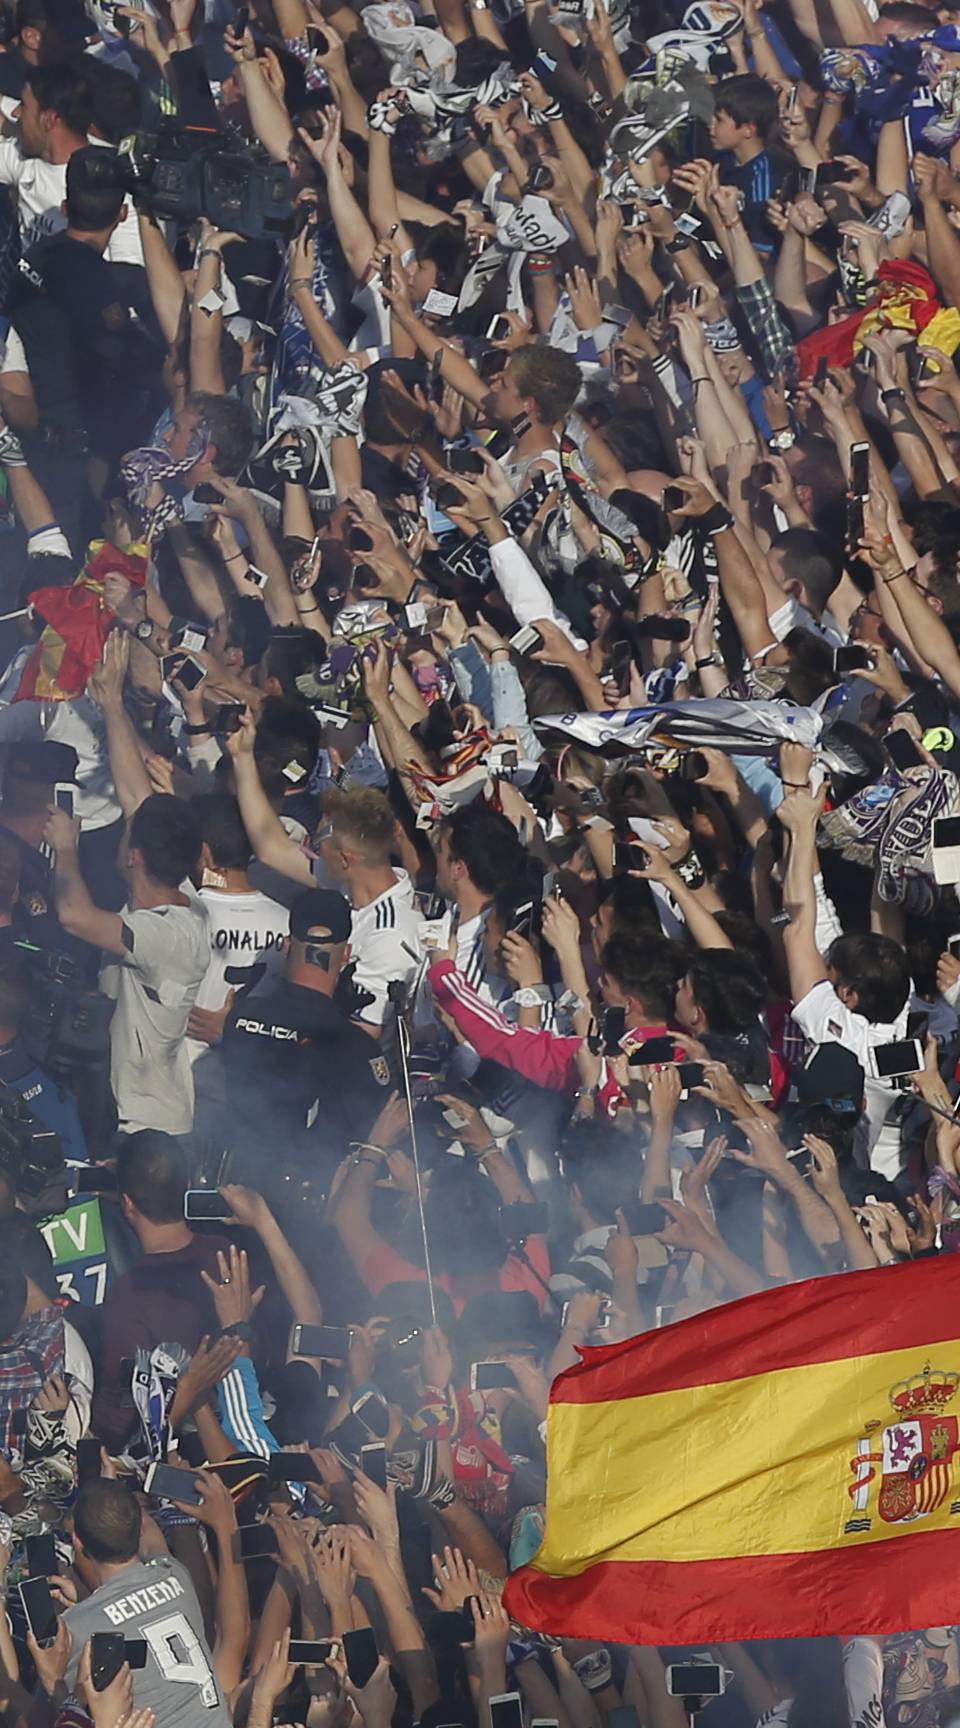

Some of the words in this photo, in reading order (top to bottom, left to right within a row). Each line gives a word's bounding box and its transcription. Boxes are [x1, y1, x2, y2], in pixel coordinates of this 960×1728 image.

[40, 1212, 87, 1259] TV
[55, 1263, 108, 1305] 37
[103, 1576, 185, 1626] BENZEMA
